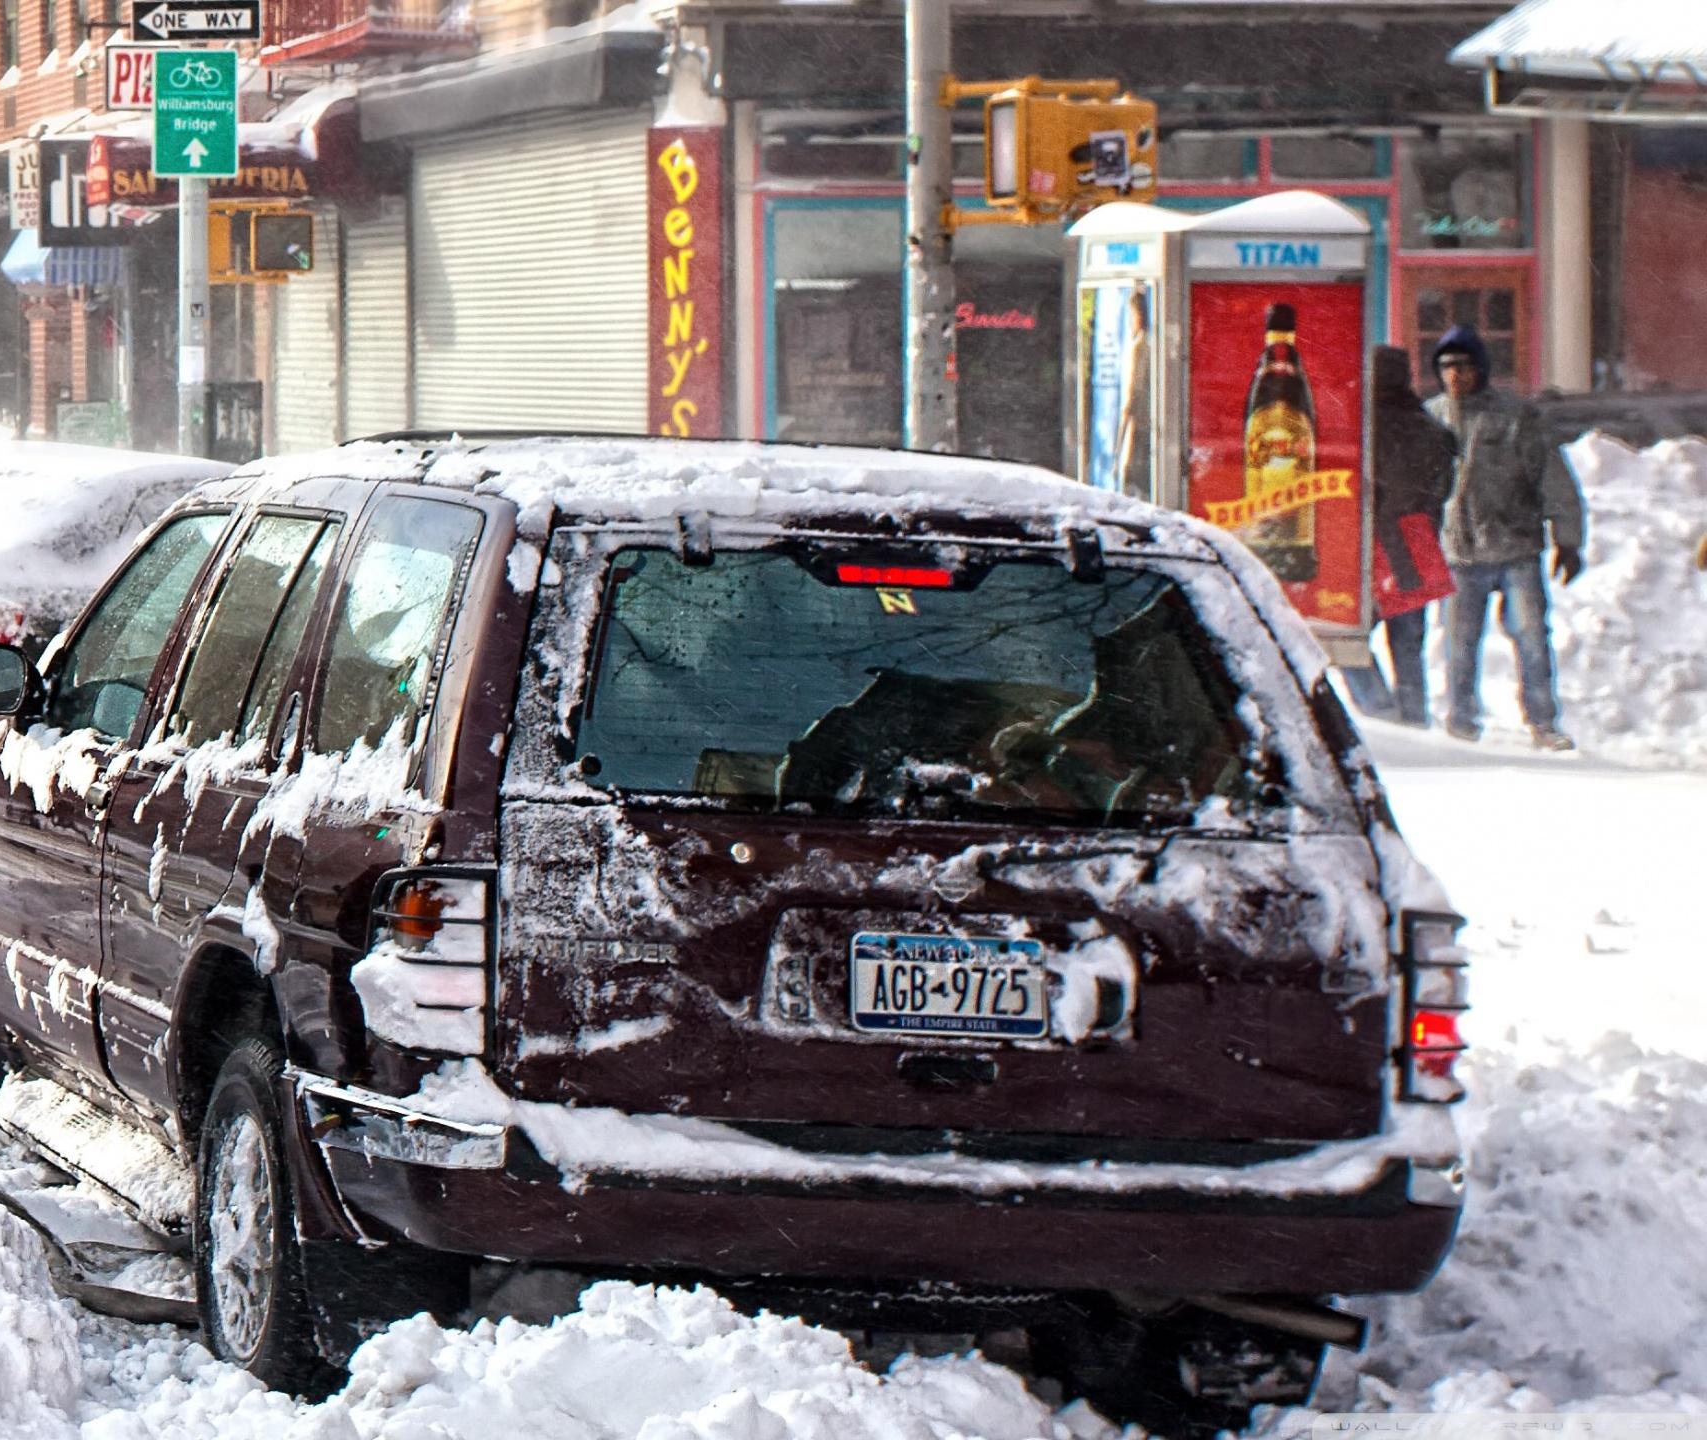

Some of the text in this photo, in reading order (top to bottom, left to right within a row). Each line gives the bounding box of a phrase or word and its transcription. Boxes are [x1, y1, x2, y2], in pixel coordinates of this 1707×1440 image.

[152, 12, 243, 29] ONE WAY
[158, 98, 235, 113] Williamsburg
[174, 118, 217, 134] Bridge
[1235, 242, 1320, 267] TITAN
[1216, 474, 1342, 521] DELICIOSO
[901, 1015, 998, 1031] THE EMPIRE STATE
